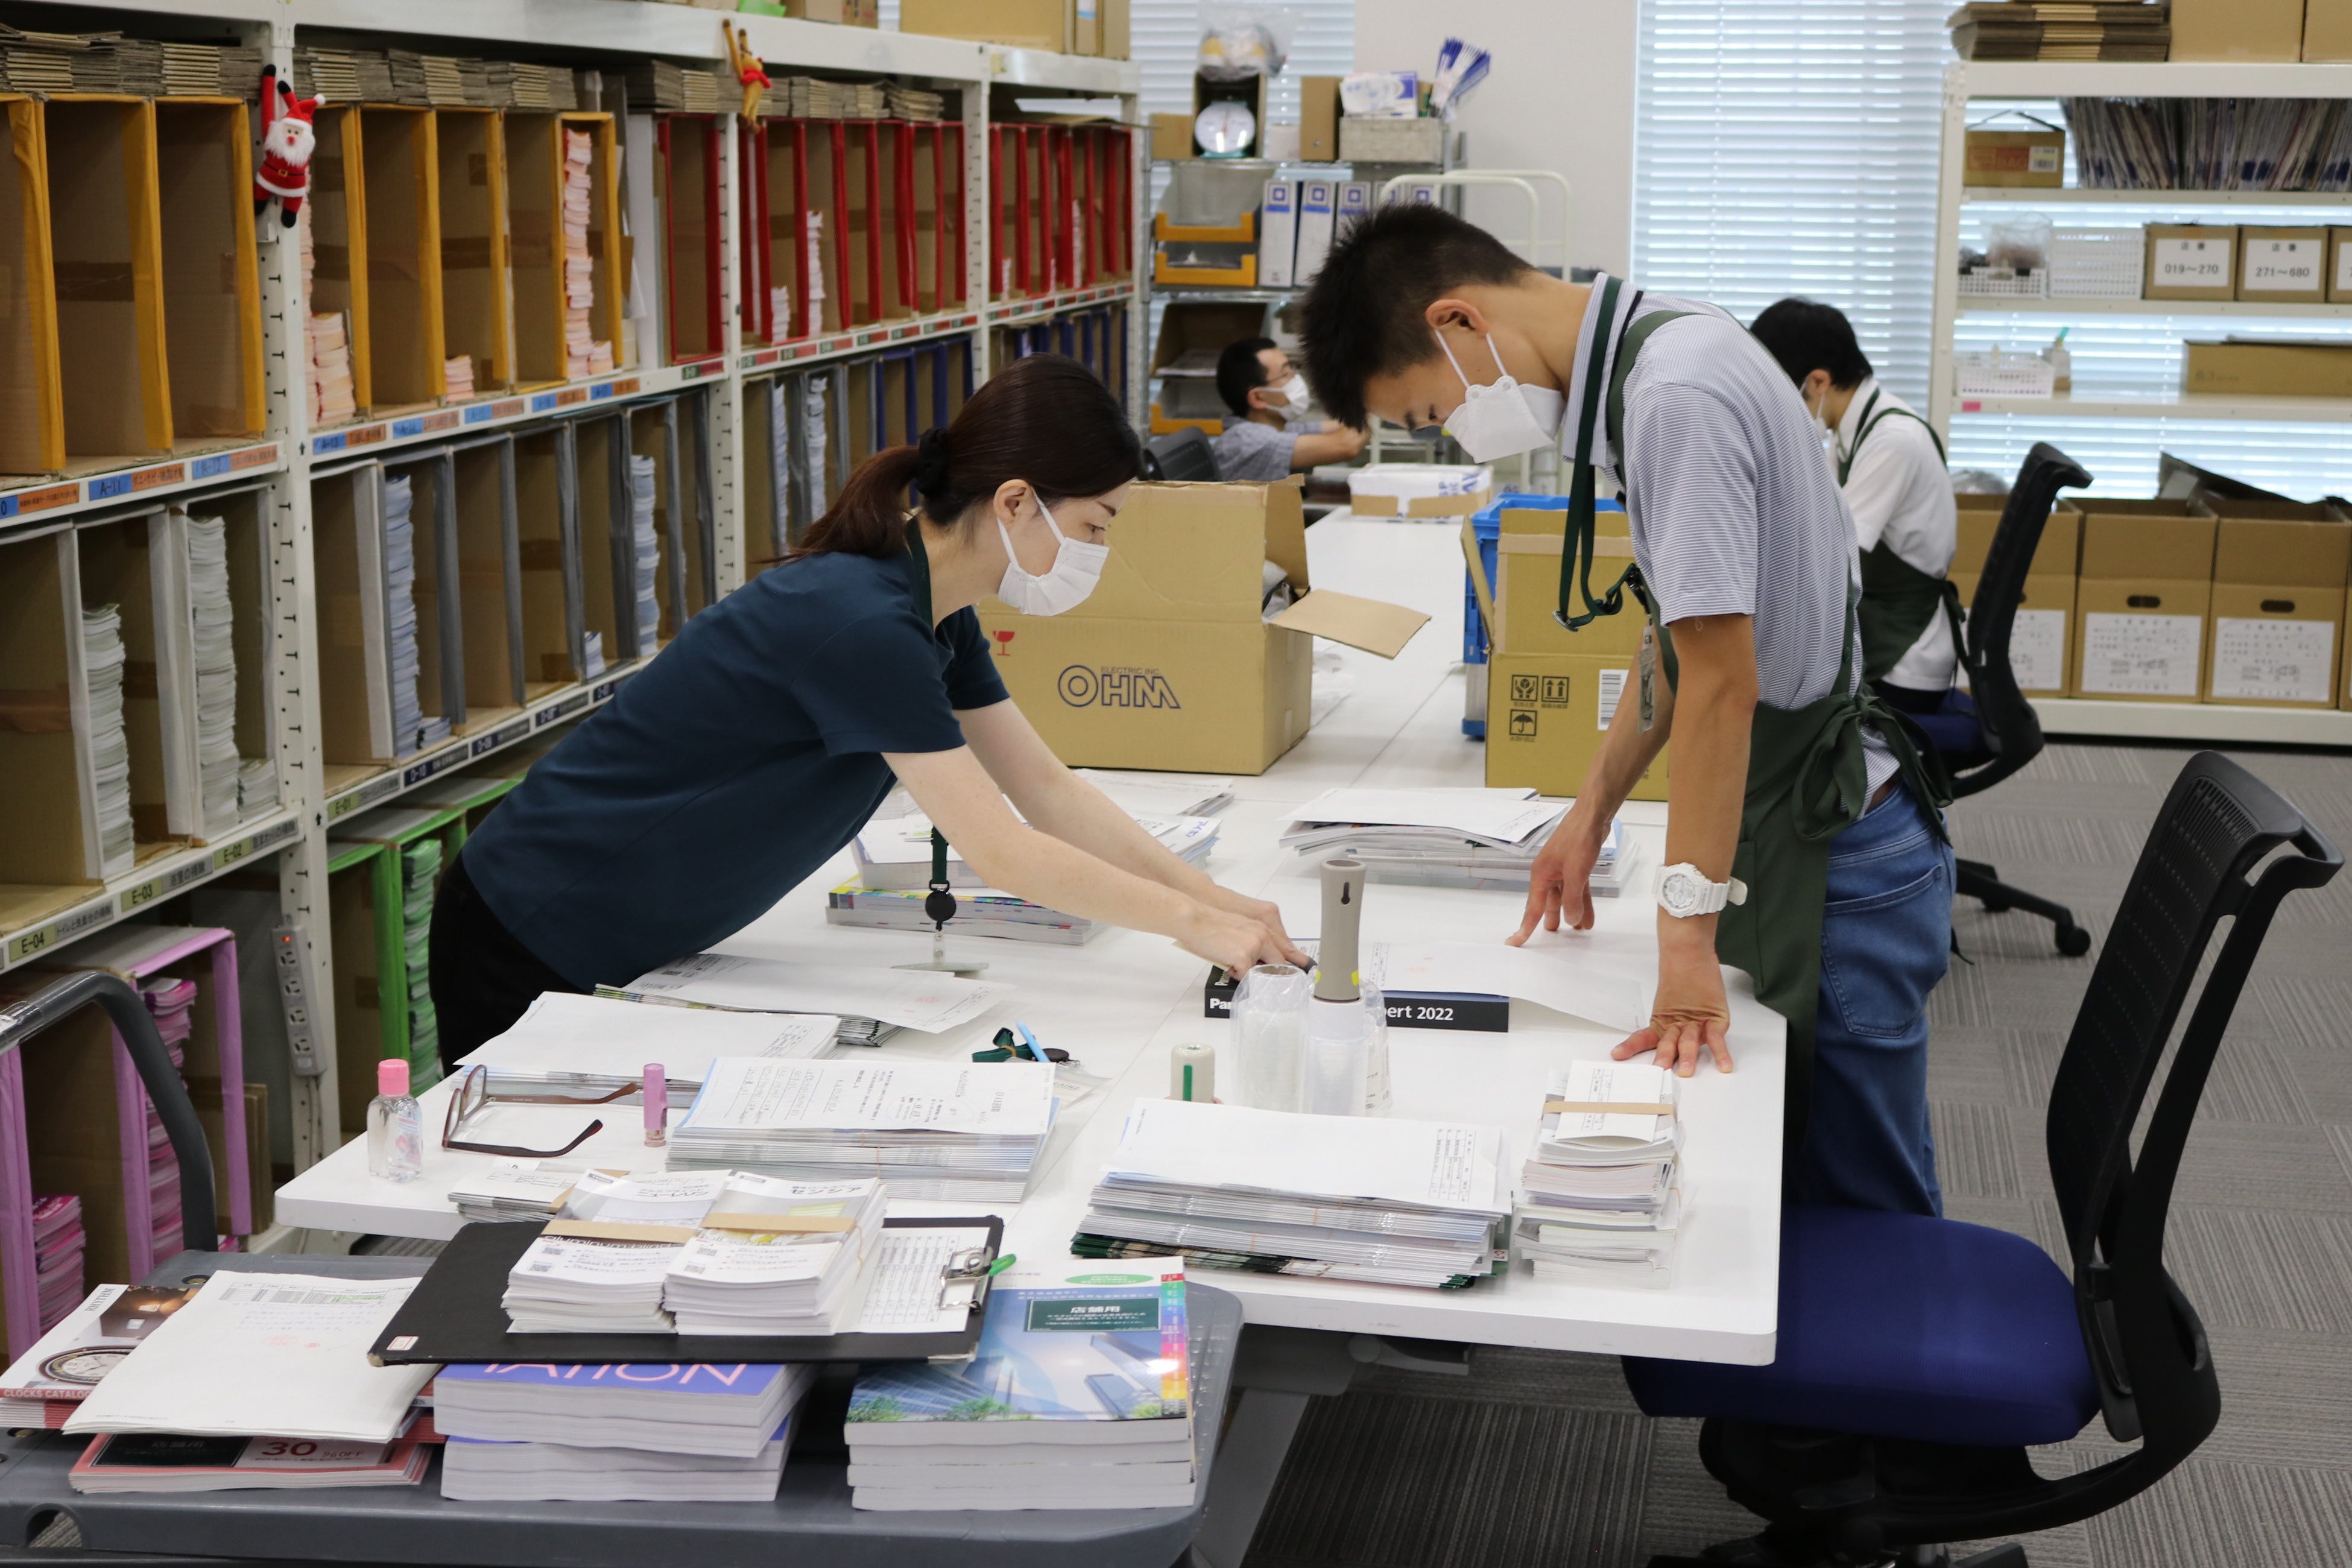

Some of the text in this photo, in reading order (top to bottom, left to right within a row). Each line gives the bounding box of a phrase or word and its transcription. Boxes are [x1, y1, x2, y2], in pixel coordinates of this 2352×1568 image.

[1058, 665, 1181, 709] OHM
[224, 844, 242, 862] E-02
[132, 884, 153, 905] E-03
[21, 931, 45, 954] E-04
[1417, 1007, 1454, 1021] 2022
[84, 1288, 115, 1311] RHYTHM
[4, 1389, 43, 1397] CLOCKS
[261, 1441, 318, 1456] 30
